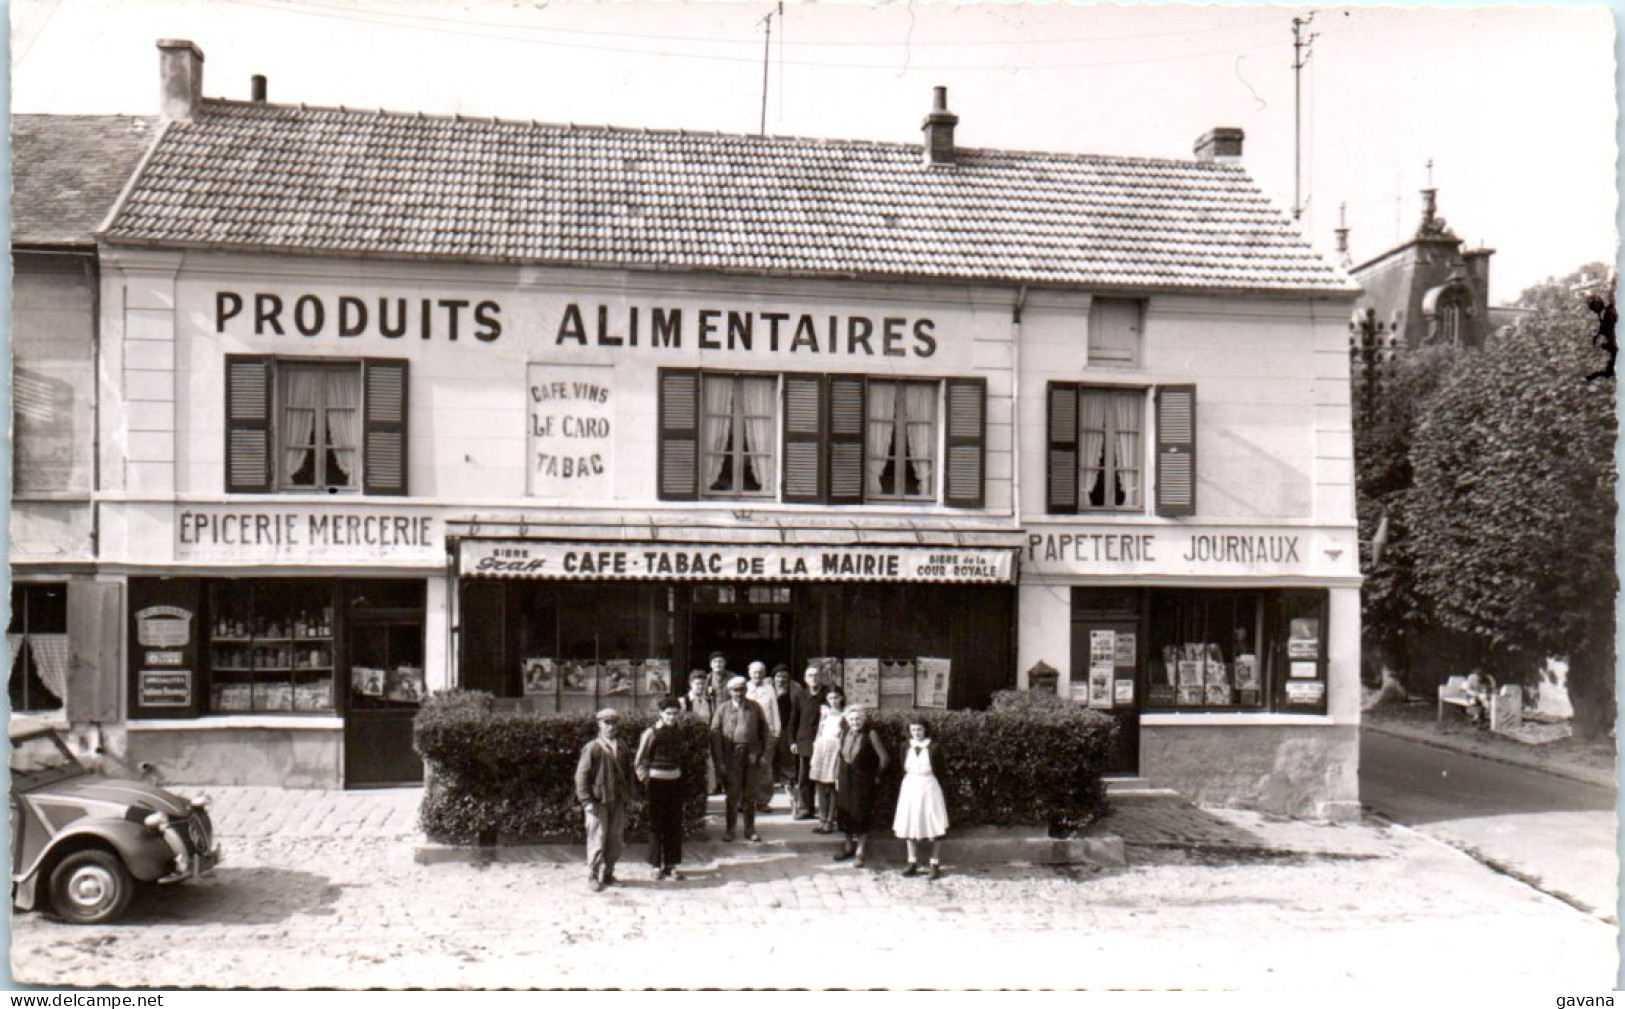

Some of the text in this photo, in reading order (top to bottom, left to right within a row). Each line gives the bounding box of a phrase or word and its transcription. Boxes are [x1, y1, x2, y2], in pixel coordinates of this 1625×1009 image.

[216, 291, 937, 358] PRODUITS ALIMENTAIRES
[573, 382, 609, 404] VINS
[562, 415, 610, 438] CARO
[537, 452, 604, 478] TABAC
[180, 511, 433, 546] ÉPICERIE MERCERIE
[1028, 534, 1300, 563] PAPETERIE JOURNAUX
[736, 557, 764, 574] DE
[780, 557, 808, 575] LA
[821, 553, 899, 576] MAIRIE
[954, 566, 997, 577] ROYALE
